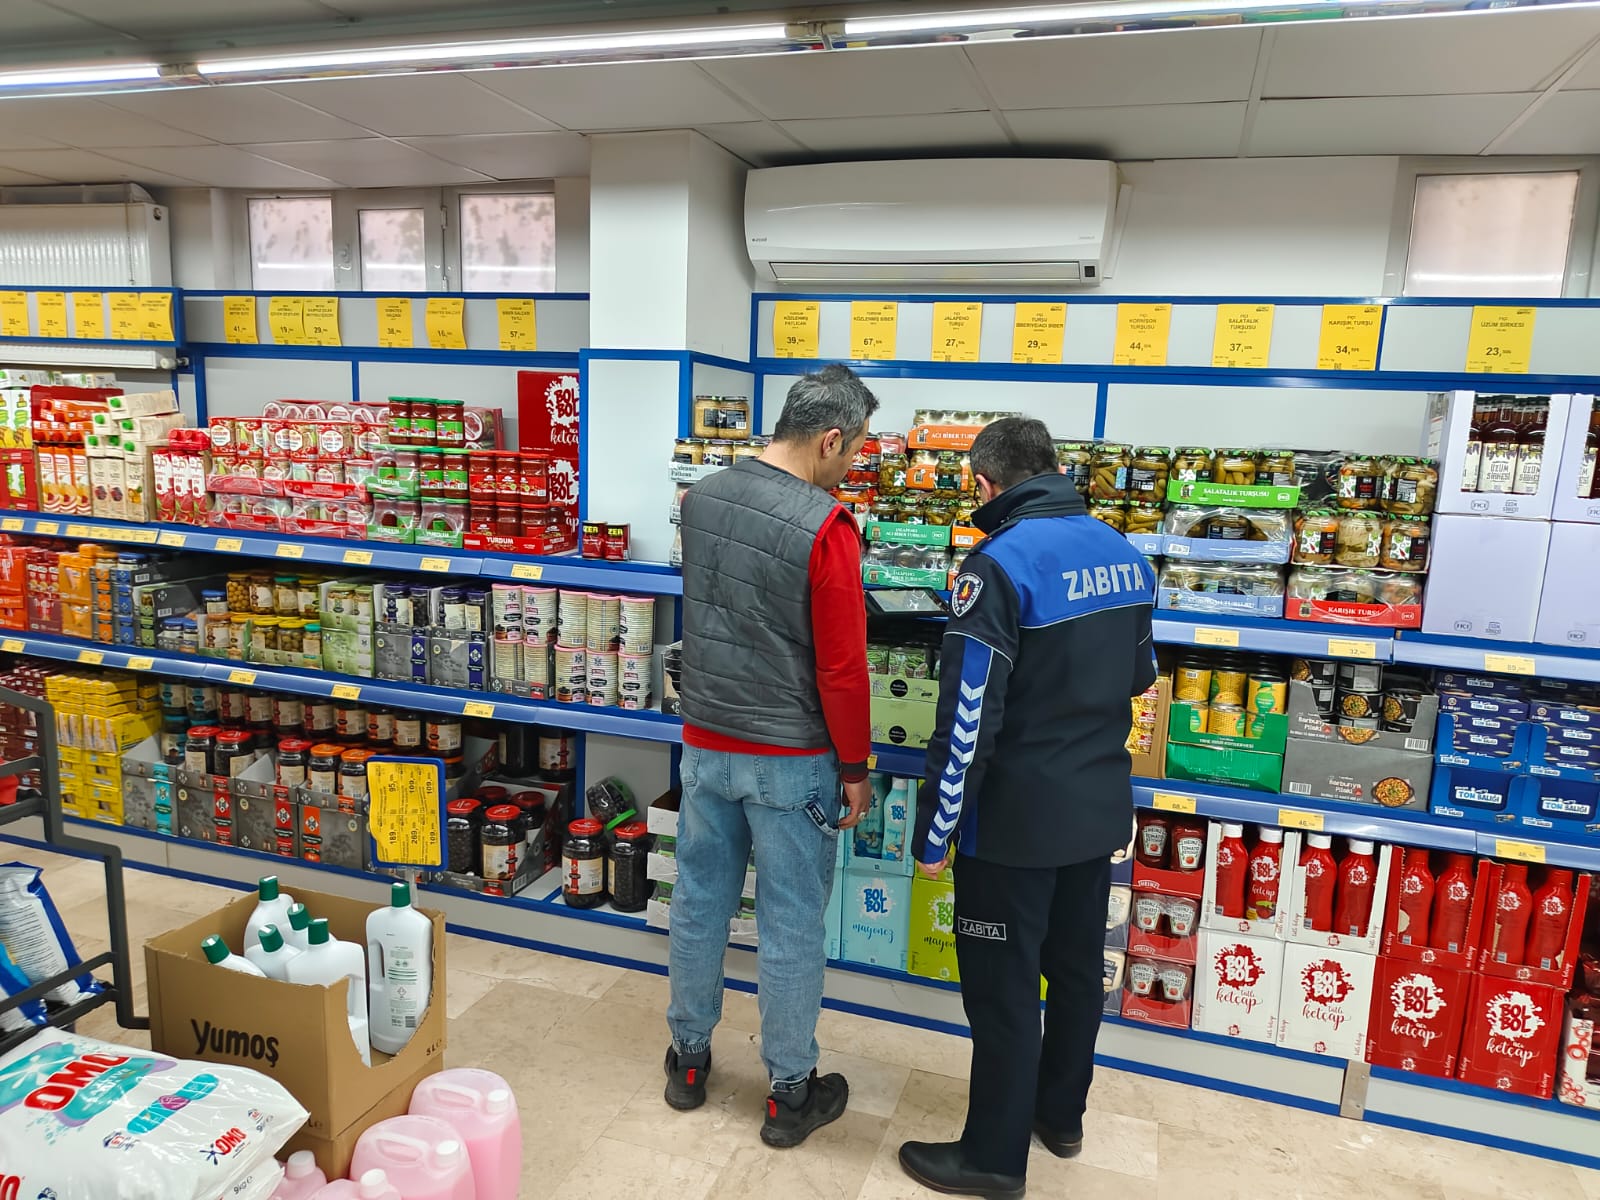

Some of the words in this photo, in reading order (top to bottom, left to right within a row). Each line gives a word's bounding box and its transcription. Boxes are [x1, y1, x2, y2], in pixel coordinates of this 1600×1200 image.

[486, 537, 514, 545] YURDUM
[1062, 563, 1145, 601] ZABITA
[864, 888, 887, 902] BOL
[864, 900, 888, 914] BOL
[938, 902, 954, 914] BO
[939, 914, 954, 927] BO
[962, 920, 1000, 937] ZABITA
[852, 923, 895, 943] mayonez
[923, 936, 956, 953] mayon
[1224, 955, 1253, 970] BOL
[1225, 967, 1255, 982] BOL
[1311, 971, 1342, 985] BOL
[1313, 984, 1345, 998] BOL
[1402, 985, 1432, 1000] BOL
[1216, 987, 1263, 1014] ketçap
[1404, 997, 1434, 1013] BOL
[1302, 1004, 1351, 1031] ketçap
[1499, 1003, 1531, 1019] BOL
[1391, 1019, 1443, 1047] ketçap
[1501, 1017, 1531, 1033] BOL
[190, 1018, 279, 1068] Yumoş
[1486, 1038, 1541, 1067] ketçap
[24, 1052, 130, 1111] OMO
[215, 1128, 247, 1155] OMO
